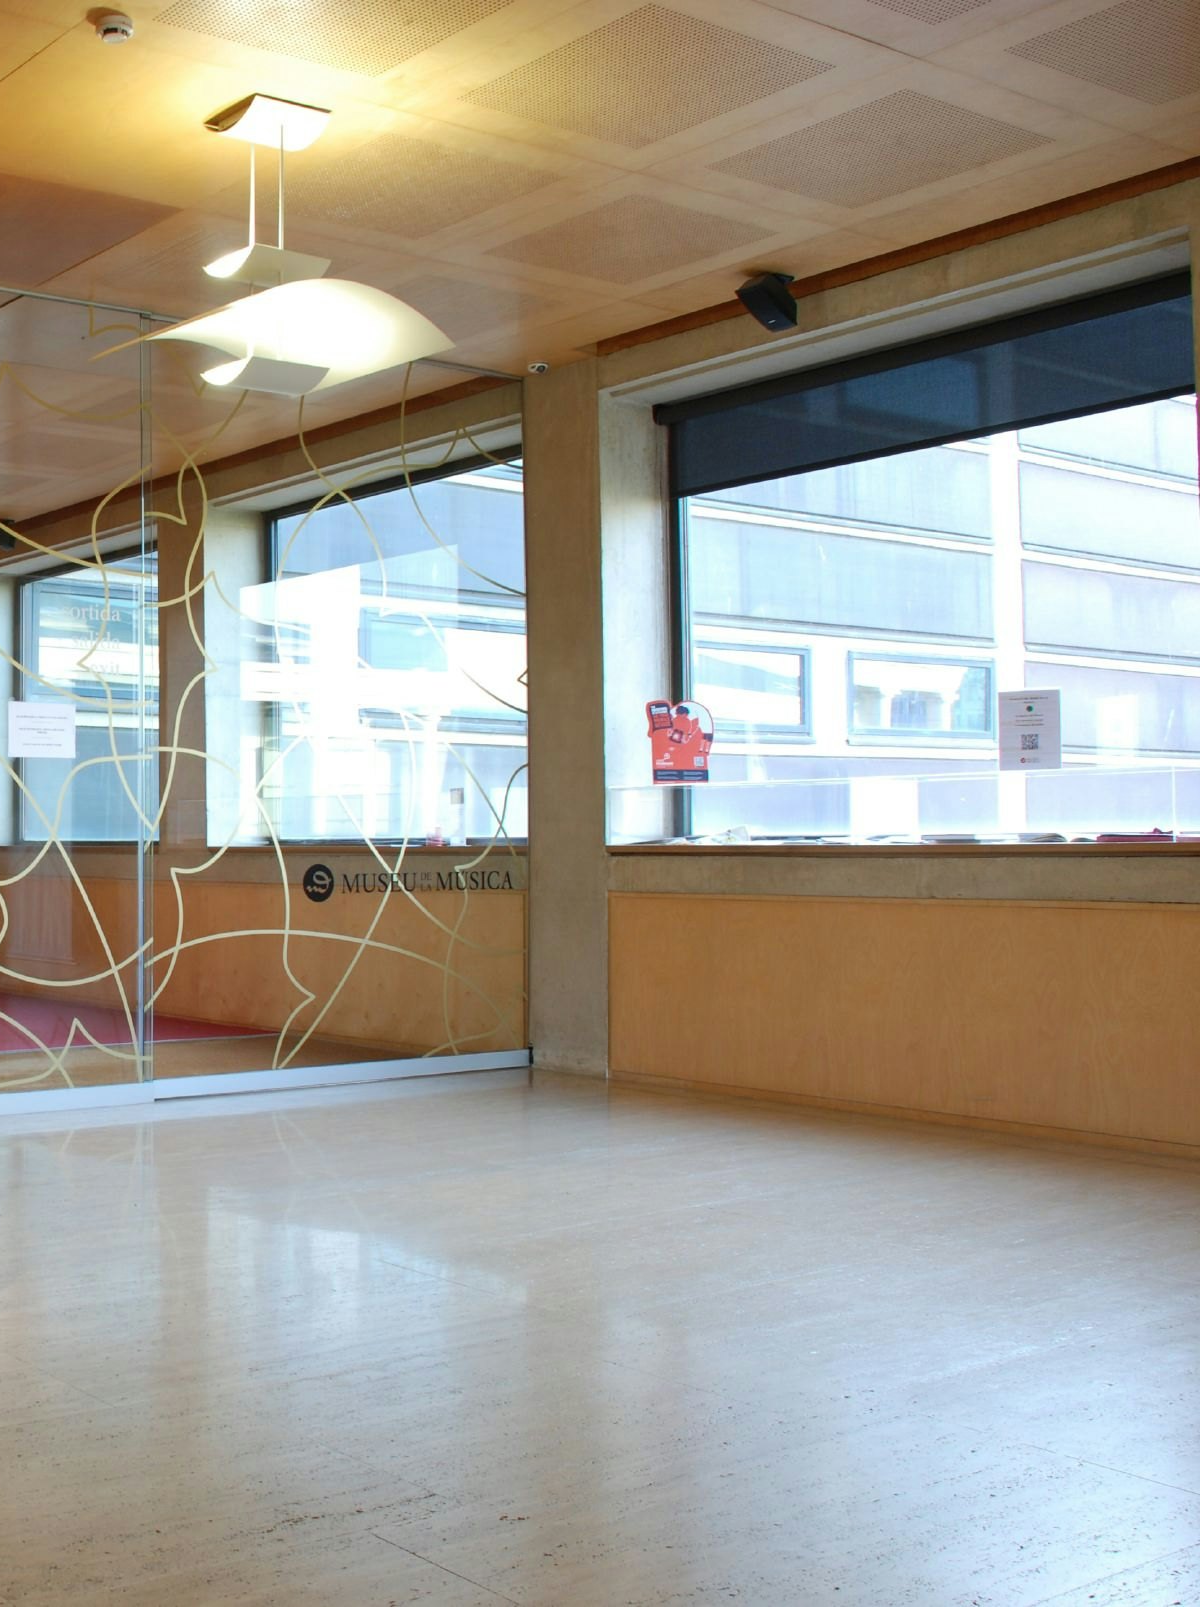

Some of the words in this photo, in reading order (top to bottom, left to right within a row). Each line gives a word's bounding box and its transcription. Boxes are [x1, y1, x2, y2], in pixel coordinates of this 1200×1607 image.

[90, 660, 120, 676] exit
[341, 872, 416, 894] MUSEU
[420, 871, 431, 881] DE
